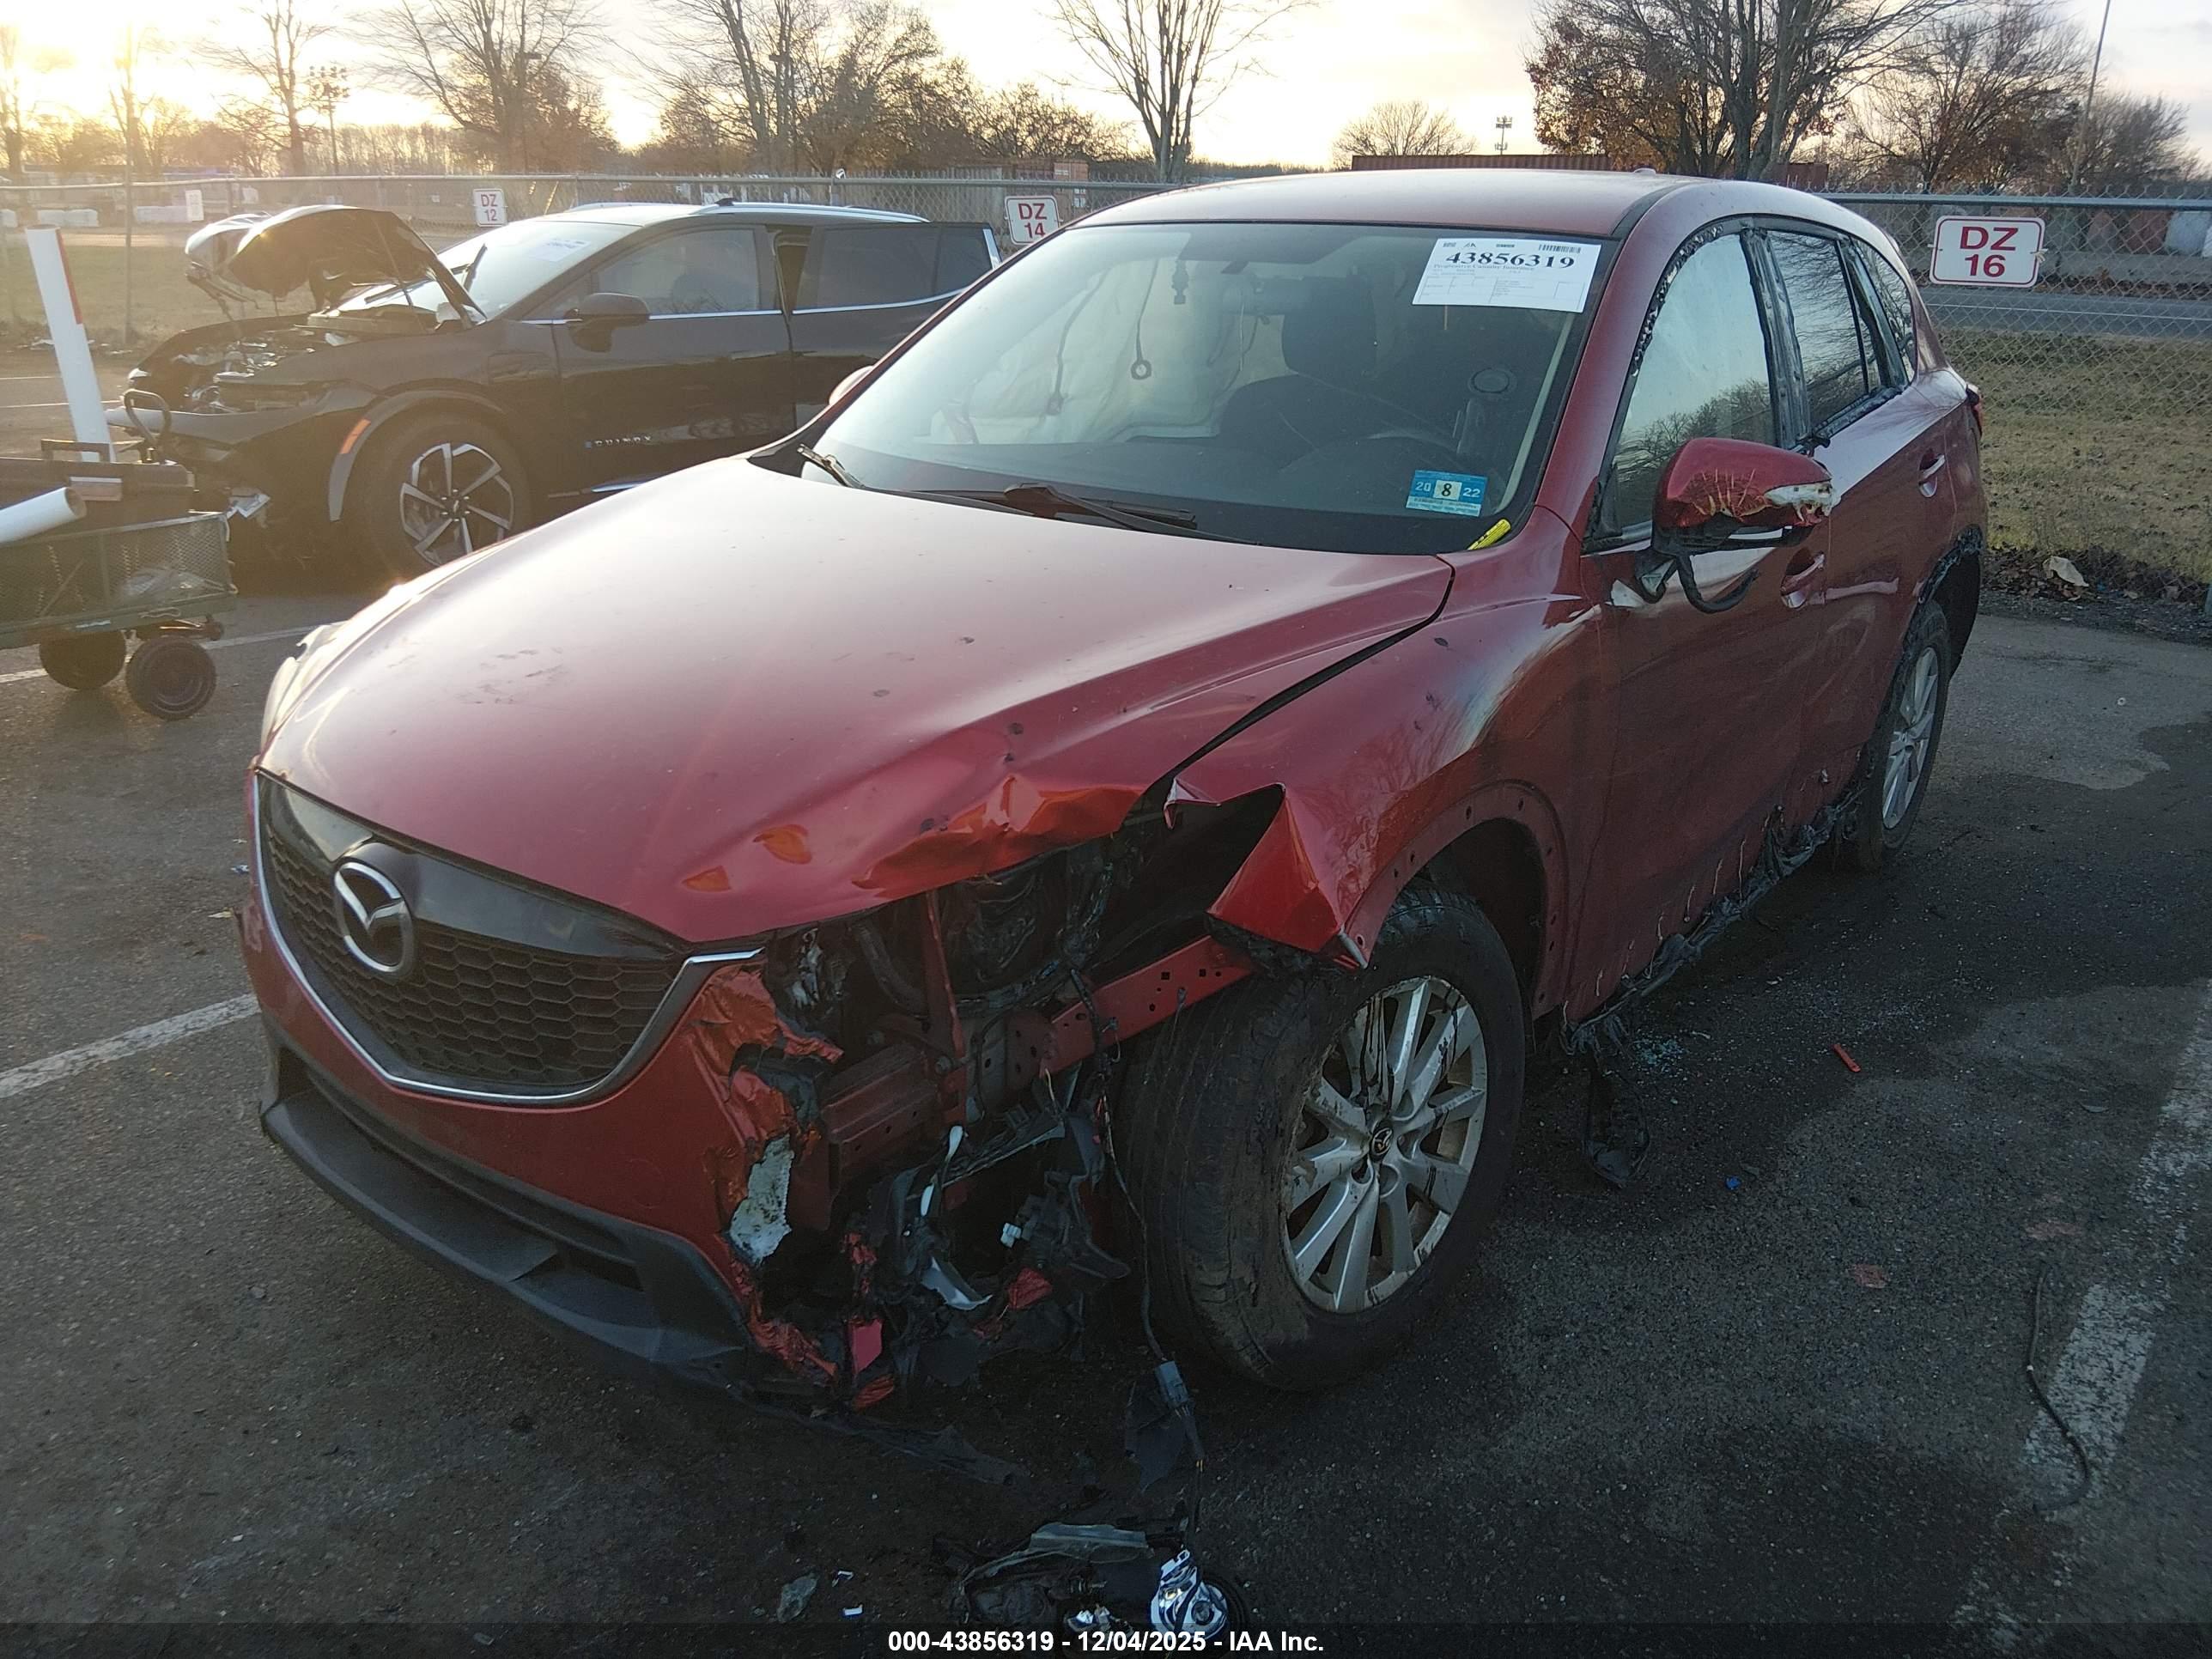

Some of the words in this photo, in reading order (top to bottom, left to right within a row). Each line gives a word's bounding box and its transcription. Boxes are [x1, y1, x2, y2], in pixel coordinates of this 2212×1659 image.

[481, 194, 498, 207] DZ
[484, 209, 497, 222] 12
[1018, 203, 1048, 220] DZ
[1024, 222, 1046, 239] 14
[1959, 226, 2019, 251] DZ
[1445, 252, 1575, 269] 43856319
[1965, 254, 2007, 277] 16
[1415, 481, 1431, 492] 20
[1442, 483, 1453, 497] 8
[1462, 487, 1480, 498] 22
